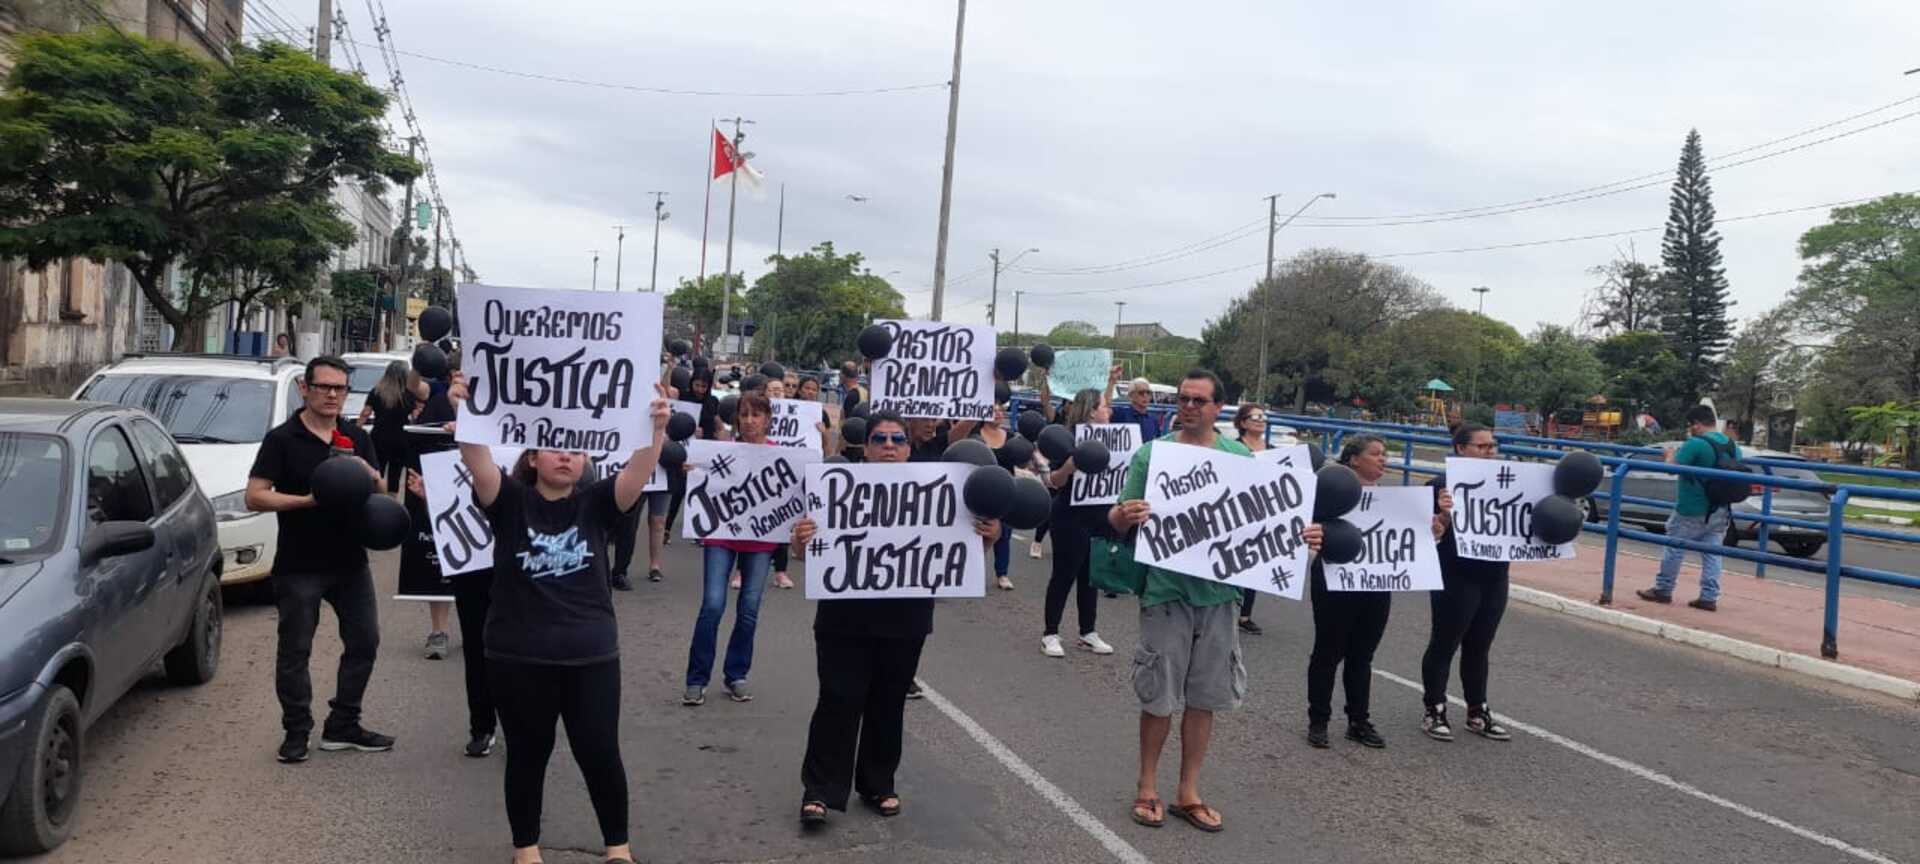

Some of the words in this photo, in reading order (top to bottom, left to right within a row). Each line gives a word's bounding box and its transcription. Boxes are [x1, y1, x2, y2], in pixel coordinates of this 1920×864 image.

[484, 299, 623, 341] QUEREMOS
[468, 339, 634, 419] JUSTIÇA
[879, 359, 979, 398] RENATO
[498, 413, 526, 444] PR
[532, 417, 620, 451] RENATO
[687, 457, 798, 537] JUSTIÇA
[821, 467, 956, 530] RENATO
[1155, 460, 1219, 500] PASTOR
[750, 496, 805, 538] RENATO
[1140, 472, 1304, 563] RENATINHO
[1453, 480, 1533, 544] JUSTIÇ
[1208, 515, 1306, 581] JUSTIÇA
[1361, 567, 1412, 590] RENATO
